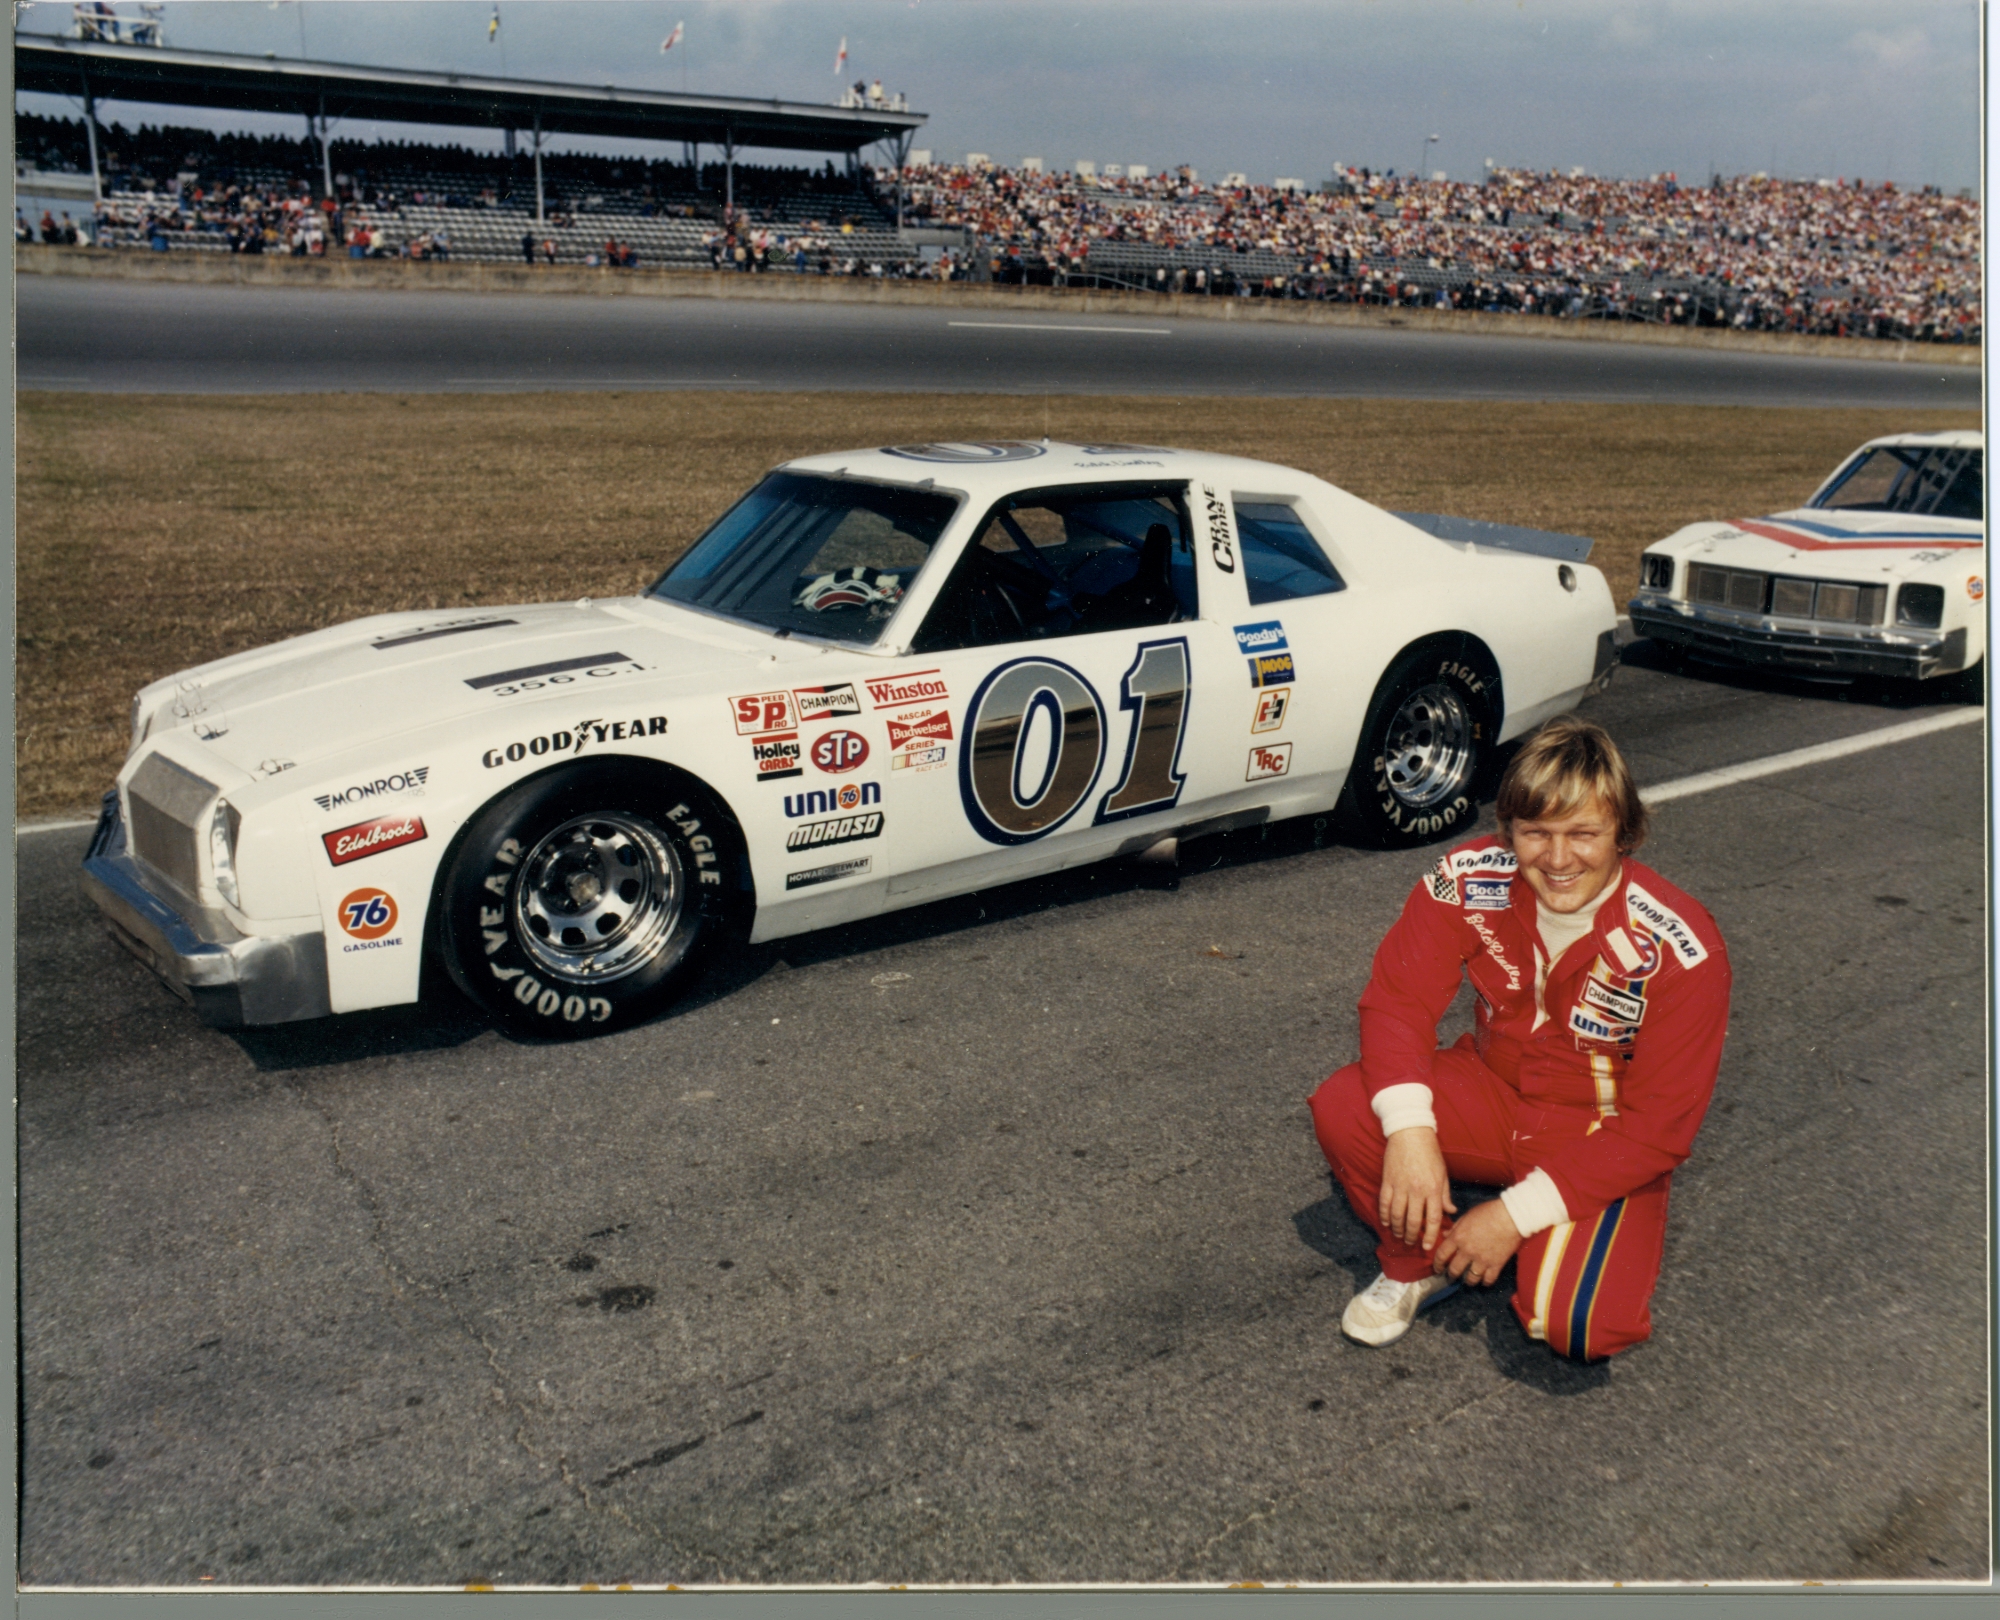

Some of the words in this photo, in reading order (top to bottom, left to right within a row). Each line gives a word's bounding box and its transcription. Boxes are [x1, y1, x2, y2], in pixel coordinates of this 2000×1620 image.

[1236, 627, 1285, 645] Goody's
[1261, 656, 1293, 674] MOOG
[1438, 661, 1484, 693] EAGLE
[493, 673, 576, 697] 356
[867, 680, 948, 703] Winston
[800, 693, 855, 710] CHAMPION
[897, 709, 932, 721] NASCAR
[482, 716, 669, 769] GOODYEAR
[891, 722, 949, 740] Budweiser
[958, 635, 1192, 846] 01
[753, 742, 801, 760] Holley
[818, 731, 863, 767] STP
[905, 739, 935, 752] SERIES
[759, 756, 795, 772] CARBS
[1255, 748, 1284, 772] TRC
[332, 770, 419, 809] MONROE
[336, 817, 416, 856] Edelbrock
[665, 803, 721, 886] EAGLE
[789, 867, 830, 884] HOWARD
[344, 894, 391, 930] 76
[479, 837, 613, 1022] GOODYEAR
[1628, 894, 1698, 959] GOODYEAR
[343, 938, 403, 953] GASOLINE
[1588, 986, 1637, 1016] CHAMPION
